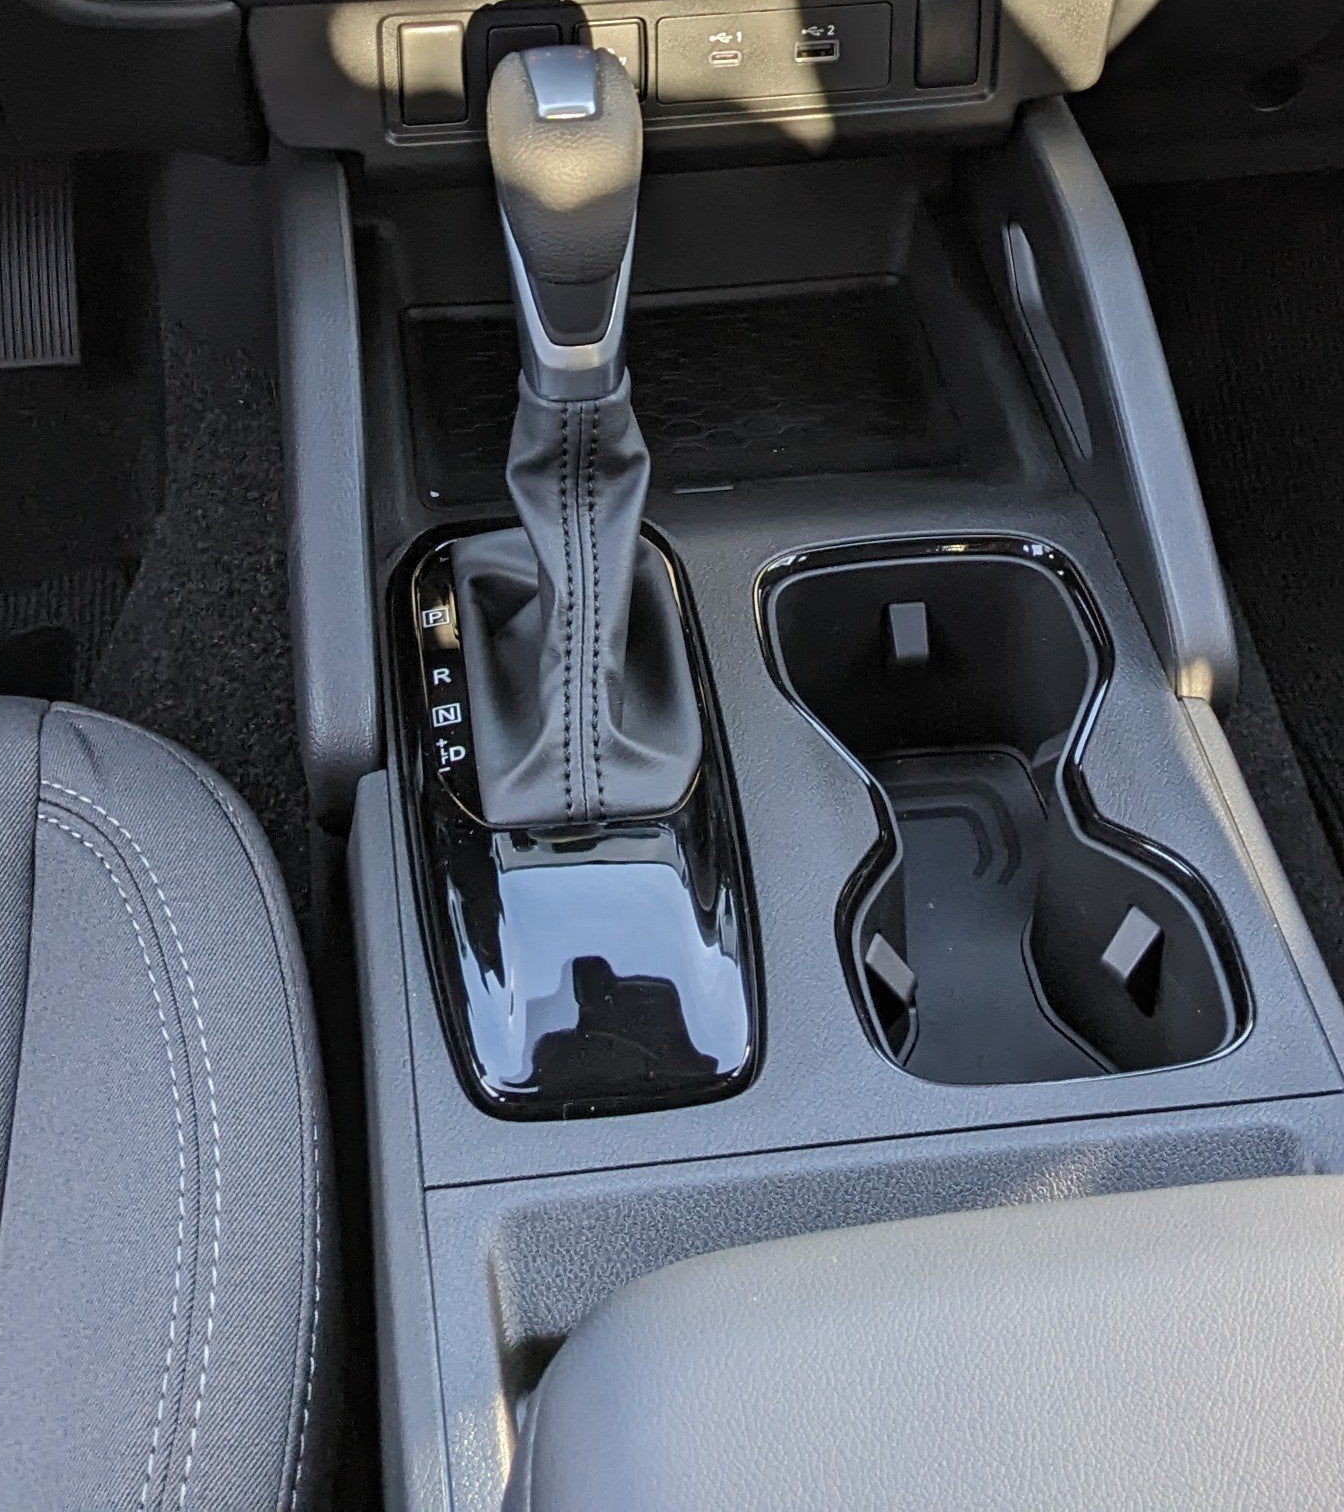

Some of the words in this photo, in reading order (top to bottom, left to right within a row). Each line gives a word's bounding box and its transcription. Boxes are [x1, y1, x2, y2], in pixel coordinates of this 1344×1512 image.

[737, 31, 742, 42] 1
[828, 26, 834, 35] 2
[429, 611, 441, 624] P
[434, 669, 452, 685] R
[438, 709, 456, 721] N
[449, 746, 465, 760] D
